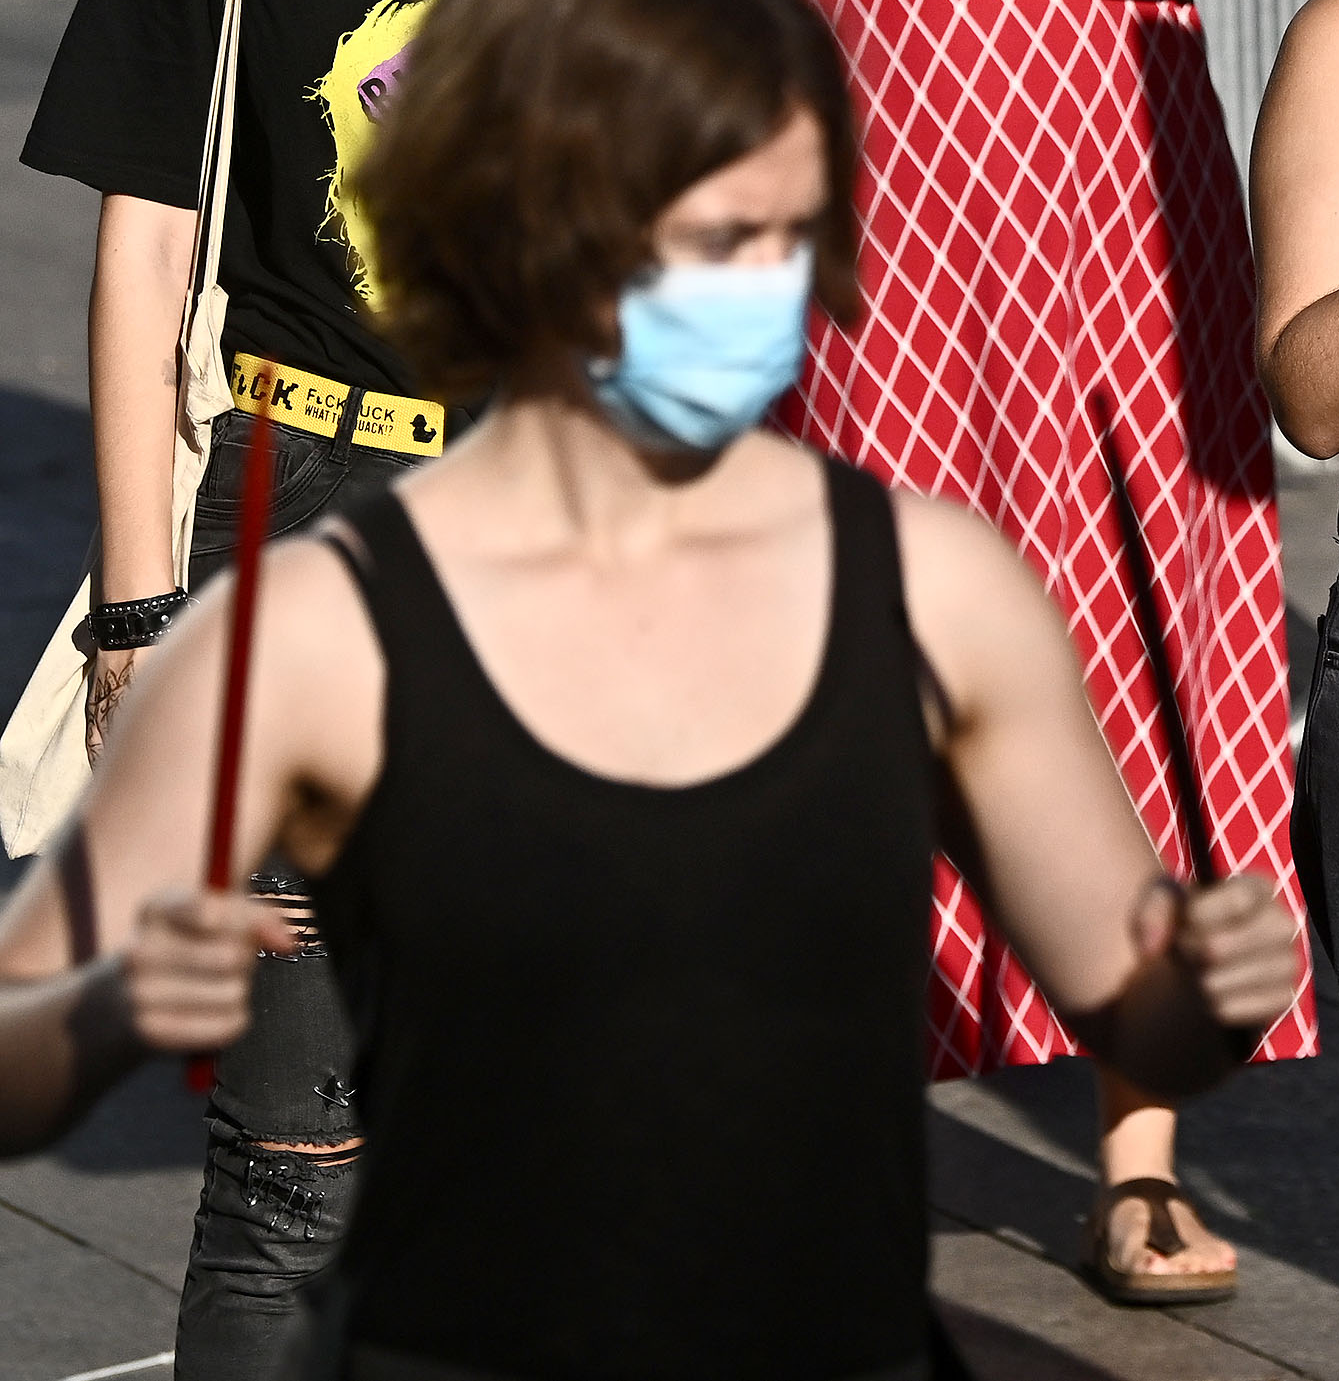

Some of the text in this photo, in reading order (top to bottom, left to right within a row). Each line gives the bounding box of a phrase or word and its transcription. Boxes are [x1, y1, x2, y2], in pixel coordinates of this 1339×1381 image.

[304, 403, 330, 422] WHAT
[354, 421, 394, 437] UACK!?
[359, 404, 396, 422] UCK
